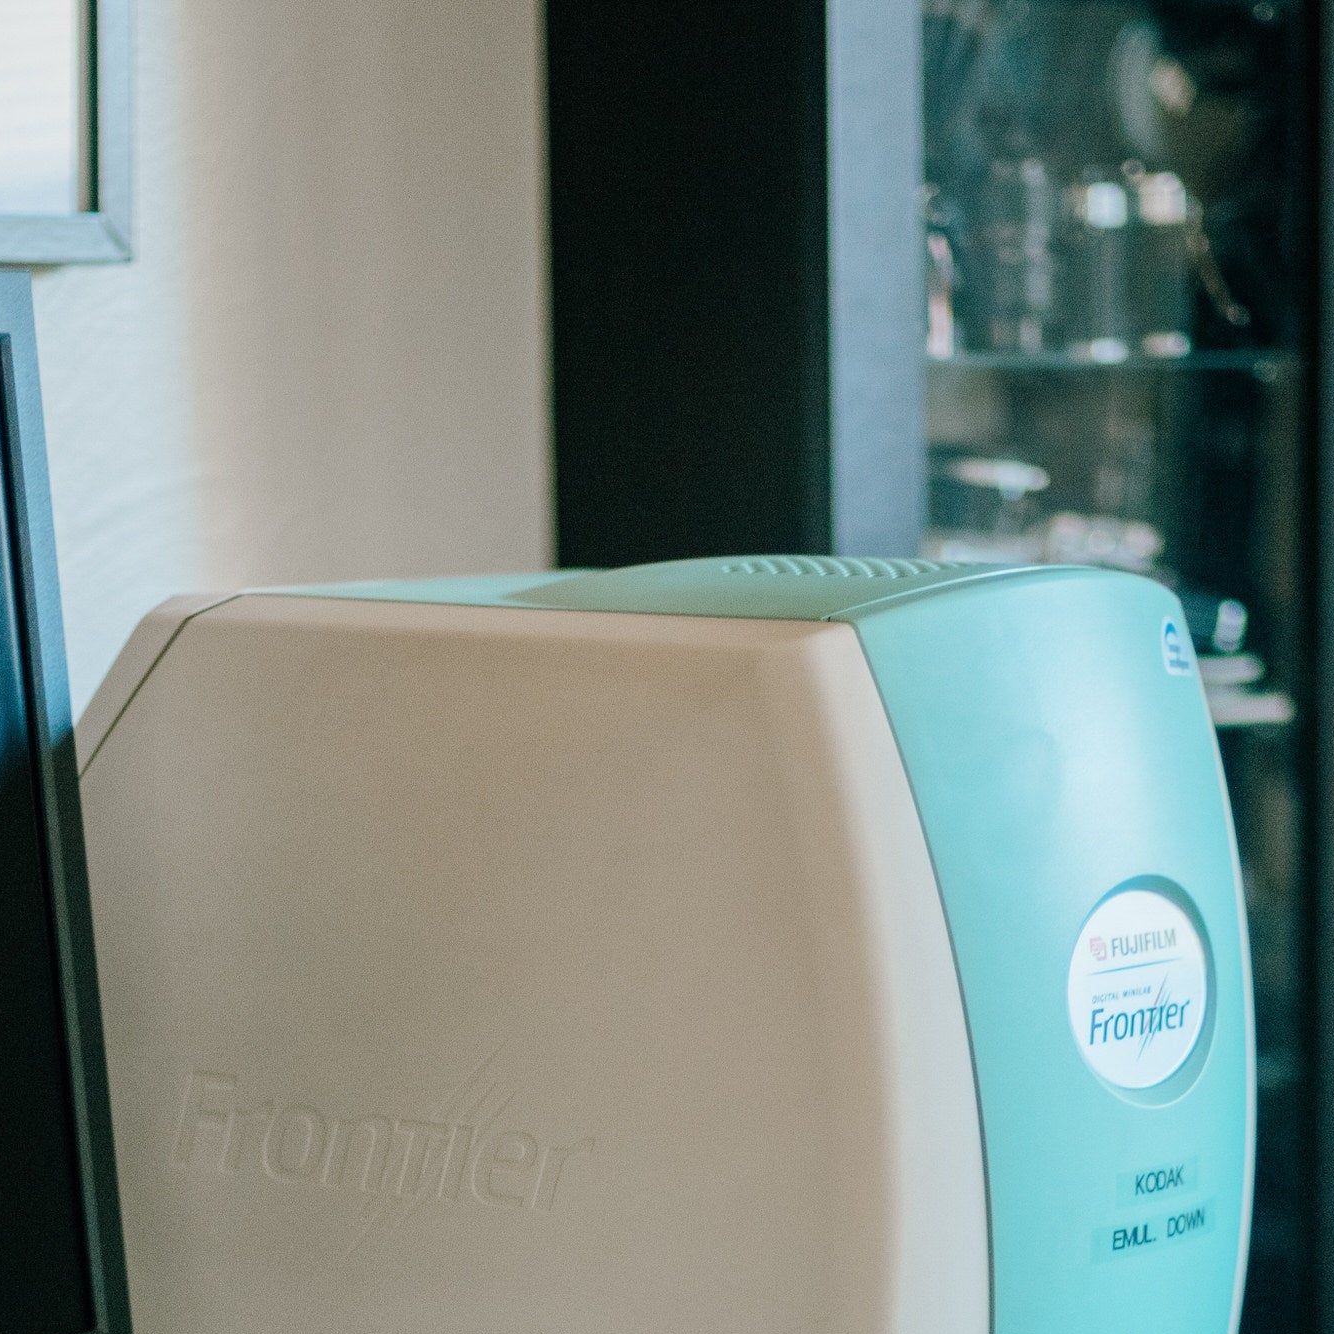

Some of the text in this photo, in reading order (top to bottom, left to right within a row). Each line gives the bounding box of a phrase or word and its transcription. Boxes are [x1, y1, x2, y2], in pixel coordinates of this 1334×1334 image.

[1111, 928, 1177, 958] FUJIFILM
[1092, 985, 1152, 1005] DIGITAL MINILAB
[1089, 999, 1191, 1046] Frontier
[169, 1068, 597, 1212] Frontier
[1135, 1164, 1184, 1196] KODAK
[1112, 1206, 1206, 1251] EMUL. DOWN
